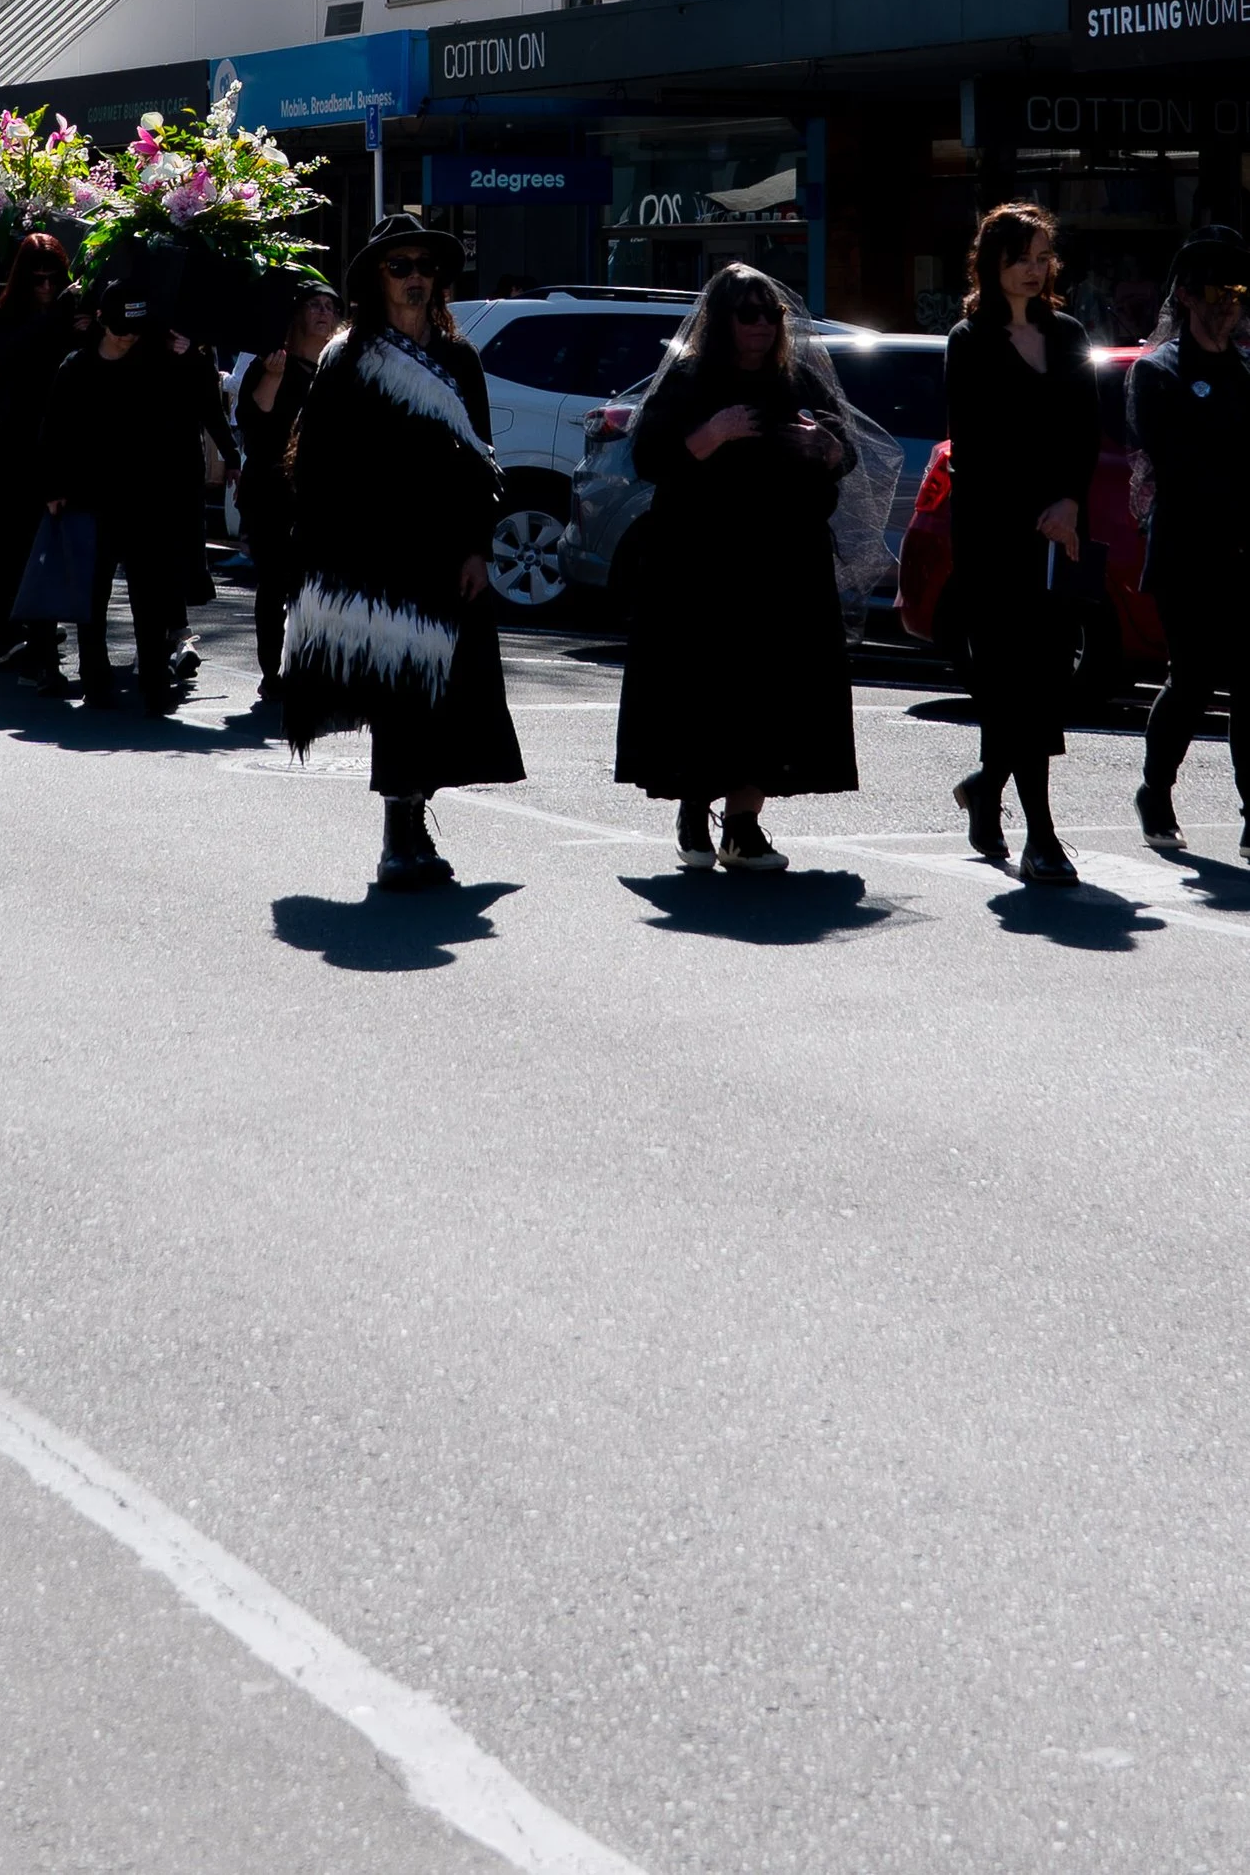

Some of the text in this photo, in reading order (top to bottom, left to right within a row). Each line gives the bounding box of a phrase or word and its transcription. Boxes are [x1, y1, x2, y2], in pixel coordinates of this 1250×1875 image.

[443, 31, 546, 80] COTTON ON
[87, 104, 123, 123] GOURMET
[280, 99, 310, 118] Mobile.
[311, 91, 356, 115] Broadband.
[1026, 95, 1250, 135] COTTON O
[469, 168, 566, 193] 2degrees
